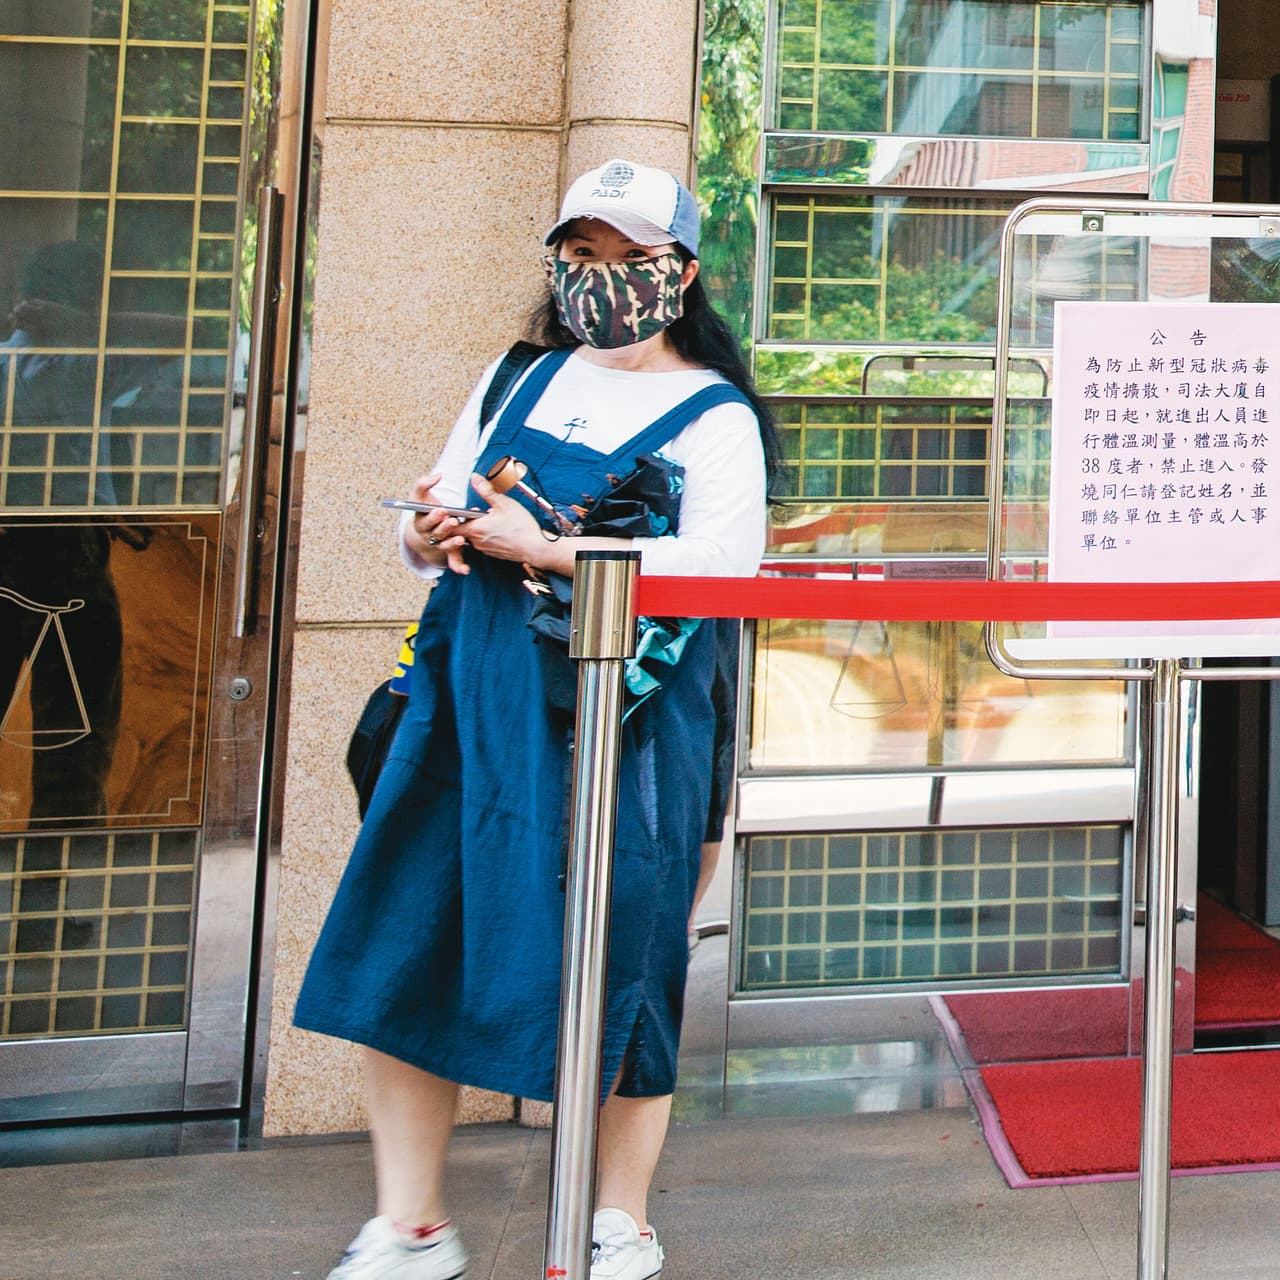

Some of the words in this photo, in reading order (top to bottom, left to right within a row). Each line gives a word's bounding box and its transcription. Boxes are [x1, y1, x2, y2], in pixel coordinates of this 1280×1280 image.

[590, 188, 626, 199] PADI
[1149, 329, 1208, 346] 公告
[1084, 356, 1270, 374] 為防止新型冠狀病毒
[1083, 382, 1266, 400] 疫情擴散，司法大廈自
[1083, 407, 1270, 424] 即日起，就進出人員進
[1082, 432, 1269, 450] 行體溫測量，體溫高於
[1080, 482, 1268, 501] 燒同仁請登記姓名，並
[1080, 506, 1268, 526] 聯絡單位主管或人事
[1080, 533, 1131, 552] 單位。
